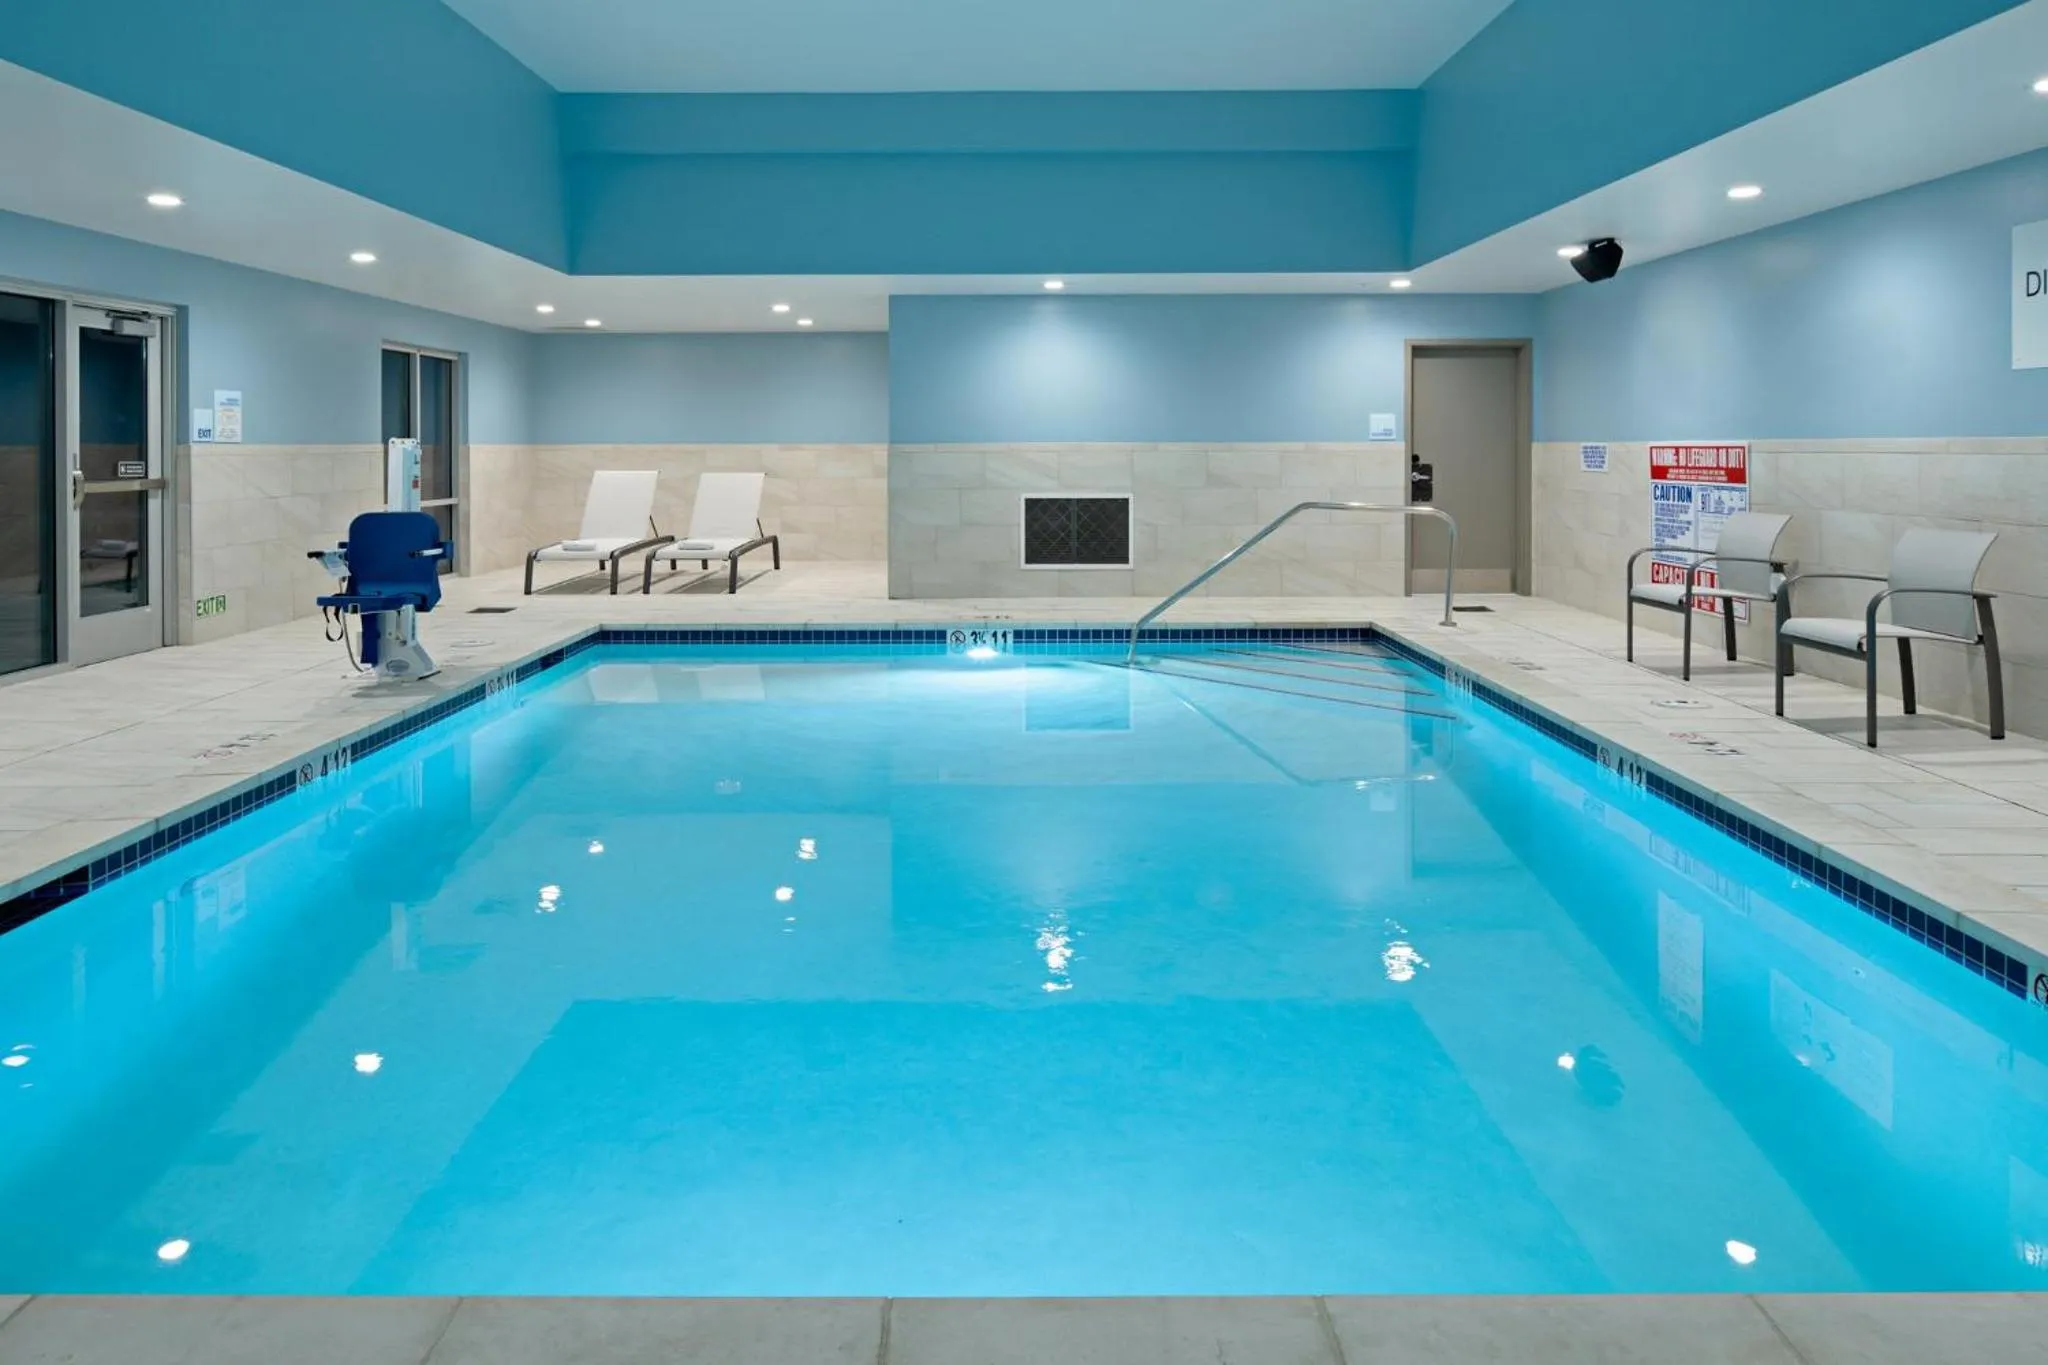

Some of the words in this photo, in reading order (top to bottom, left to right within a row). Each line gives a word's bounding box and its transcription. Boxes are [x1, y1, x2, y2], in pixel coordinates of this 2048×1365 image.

[2026, 269, 2048, 297] DI
[198, 428, 211, 439] EXIT
[1728, 448, 1744, 469] DUTY
[1654, 485, 1693, 503] CAUTION
[1653, 564, 1687, 585] CAPACIT
[196, 596, 215, 617] EXIT
